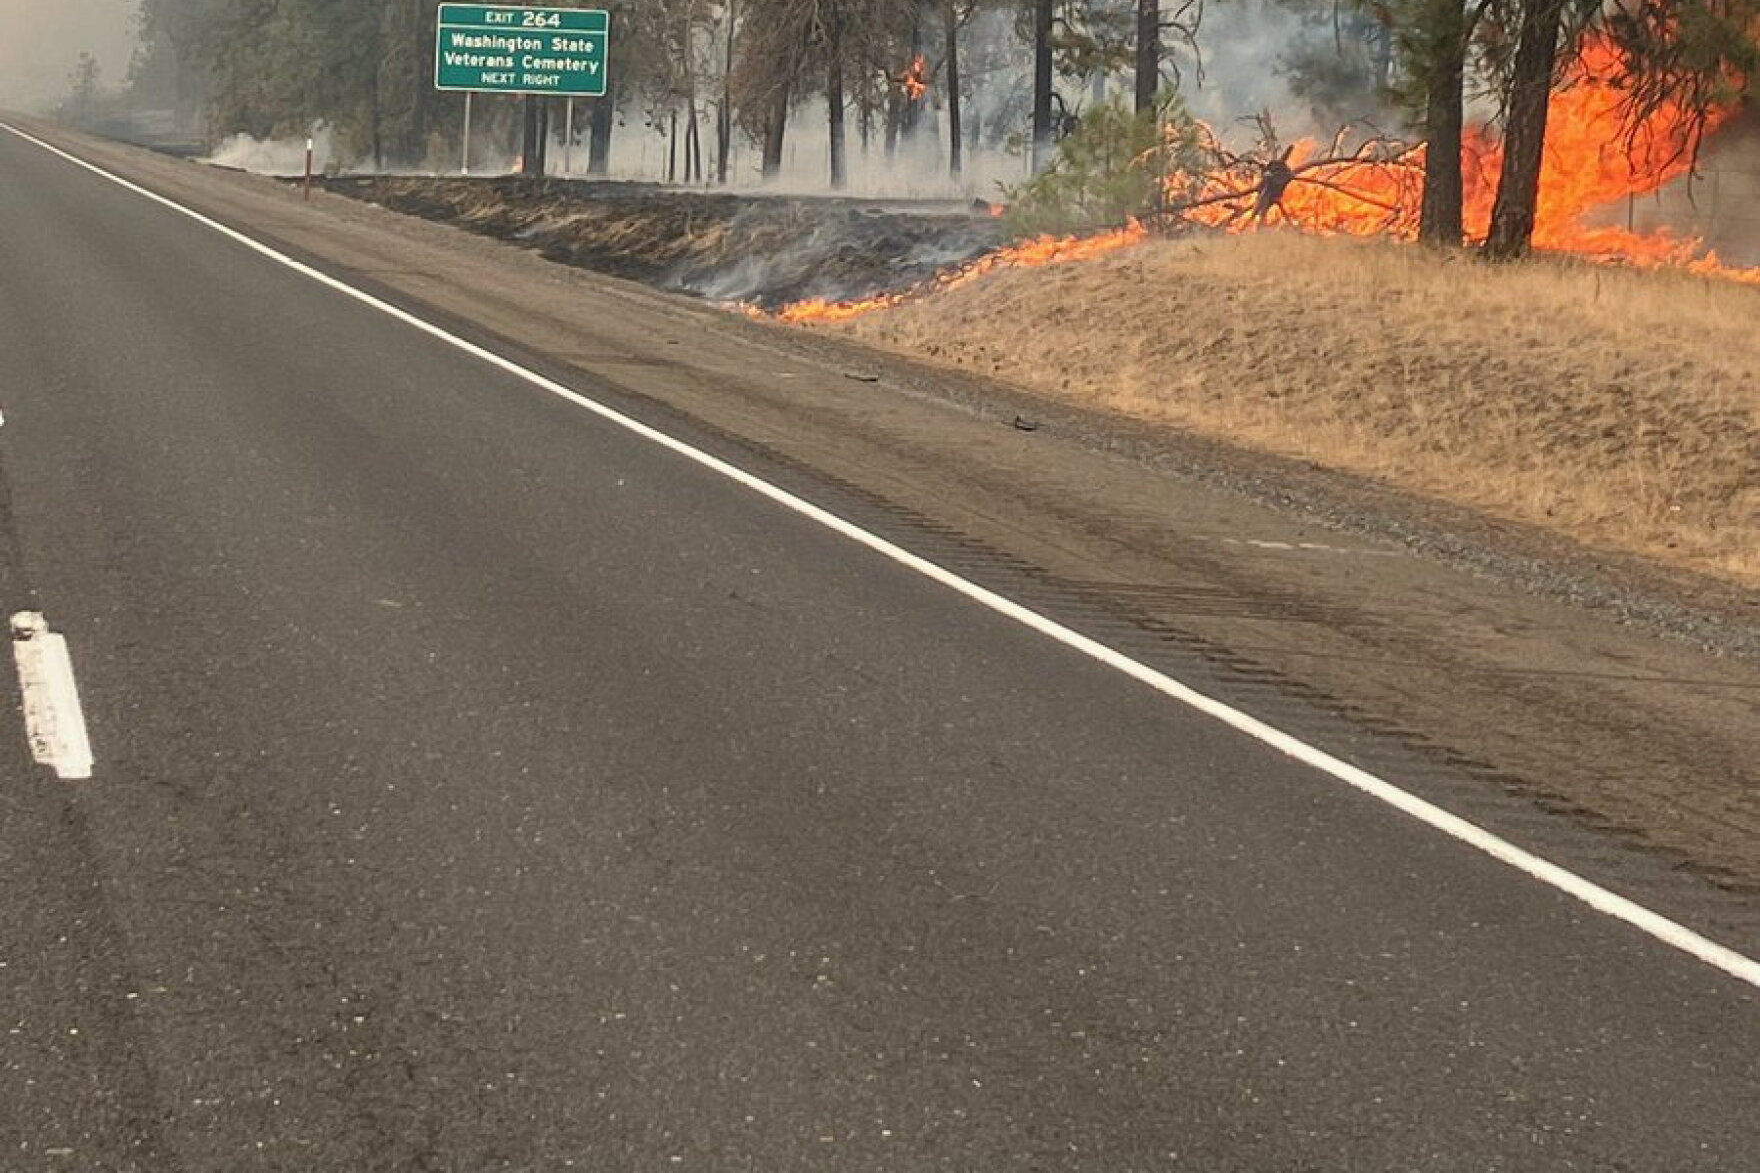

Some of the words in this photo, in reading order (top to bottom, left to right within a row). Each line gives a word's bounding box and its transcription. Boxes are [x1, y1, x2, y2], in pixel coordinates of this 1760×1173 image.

[485, 11, 514, 23] EXIT
[521, 11, 561, 27] 264
[451, 33, 542, 53] Washington
[551, 36, 595, 52] State
[444, 51, 514, 68] Veterans
[521, 54, 600, 75] Cemetery
[481, 72, 516, 84] NEXT
[521, 73, 561, 86] RIGHT
